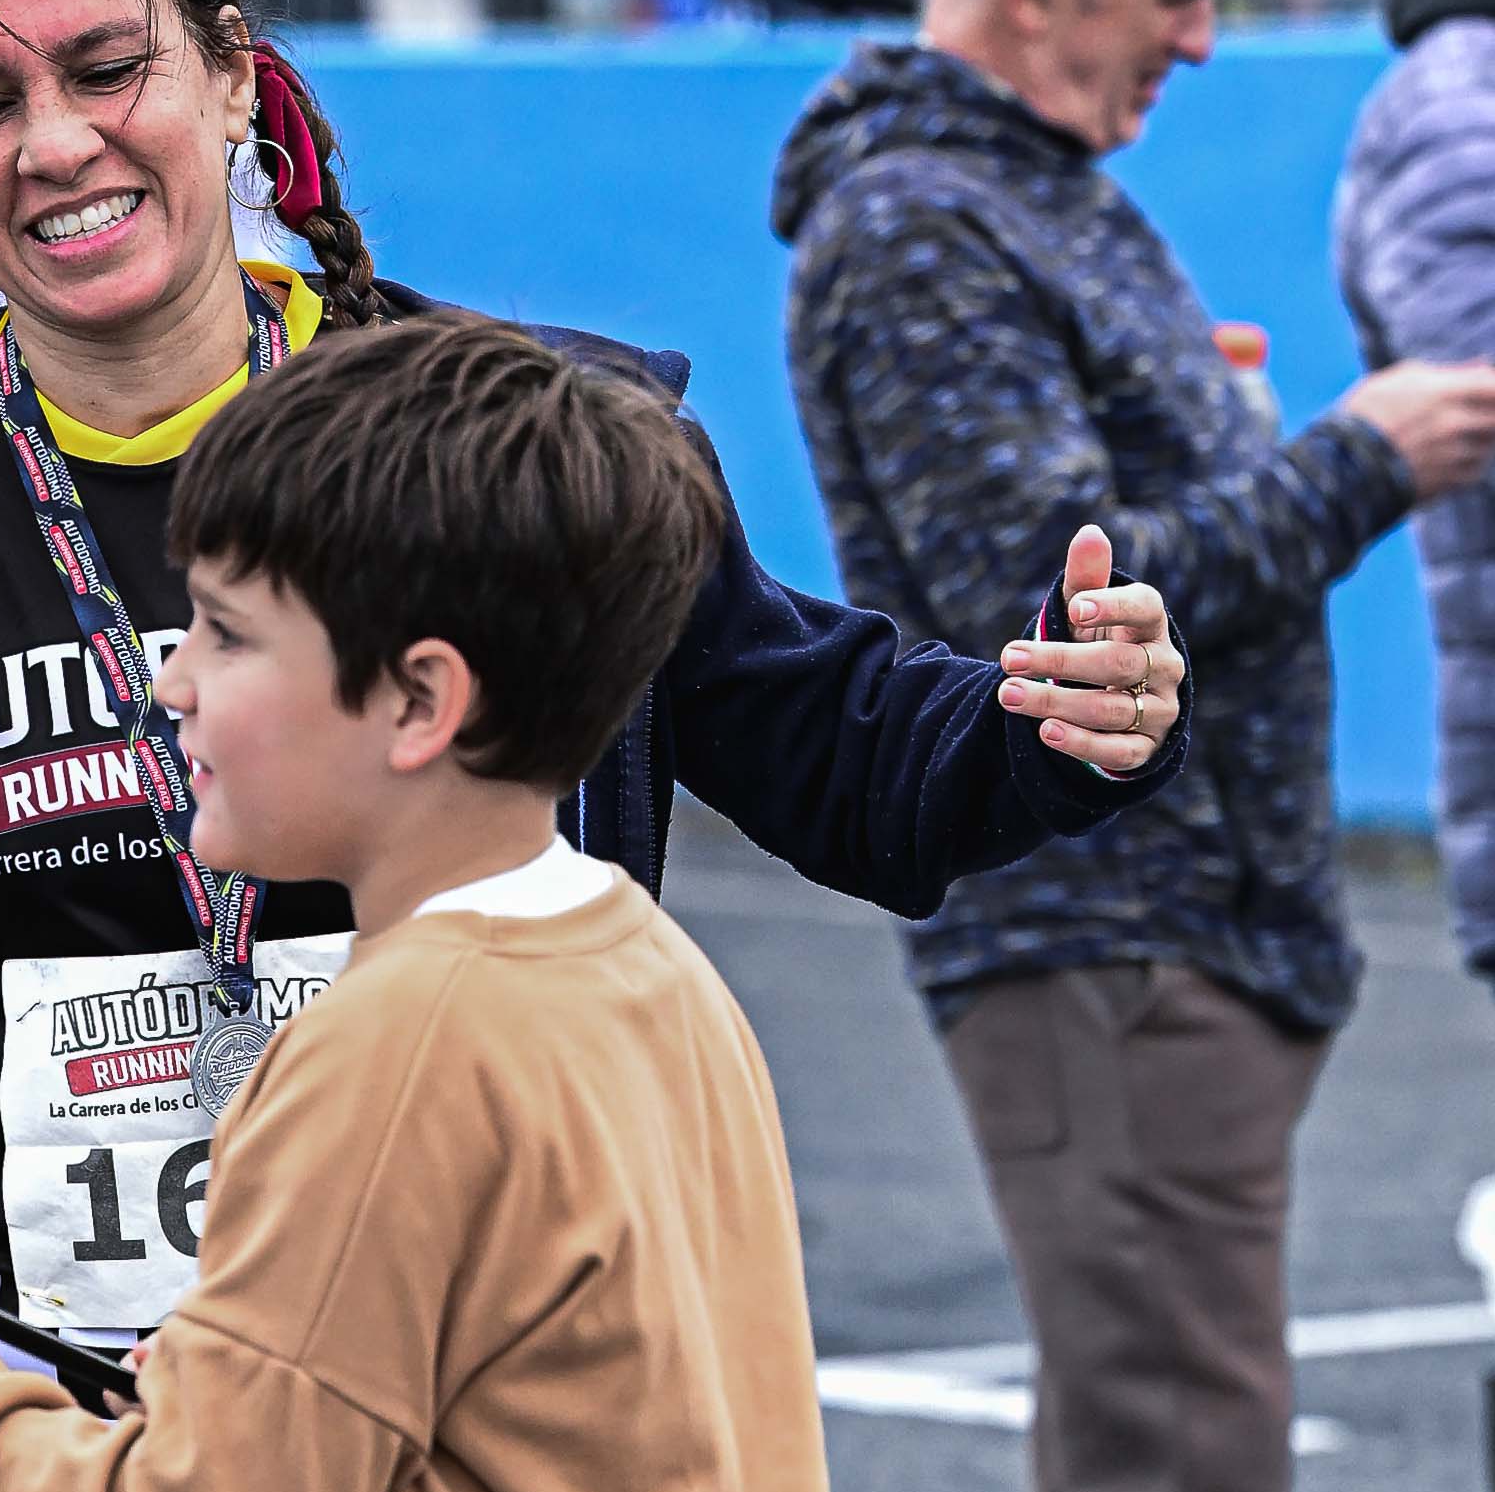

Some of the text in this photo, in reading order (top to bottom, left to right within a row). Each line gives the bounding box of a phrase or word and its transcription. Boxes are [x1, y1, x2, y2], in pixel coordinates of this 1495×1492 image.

[16, 439, 46, 496] RUNNING RACE
[52, 532, 84, 589] RUNNING RACE
[95, 639, 129, 698] RUNNING RACE
[2, 748, 147, 824] RUNN
[139, 746, 171, 807] RUNNING RACE
[71, 836, 109, 865] de
[119, 832, 163, 860] los
[180, 859, 211, 923] RUNNING RACE
[243, 889, 255, 915] RACE
[92, 1047, 191, 1089] RUNNIN
[49, 1102, 66, 1118] La
[68, 1100, 126, 1118] Carrera
[130, 1097, 151, 1114] de
[155, 1095, 179, 1111] los
[66, 1138, 215, 1262] 16
